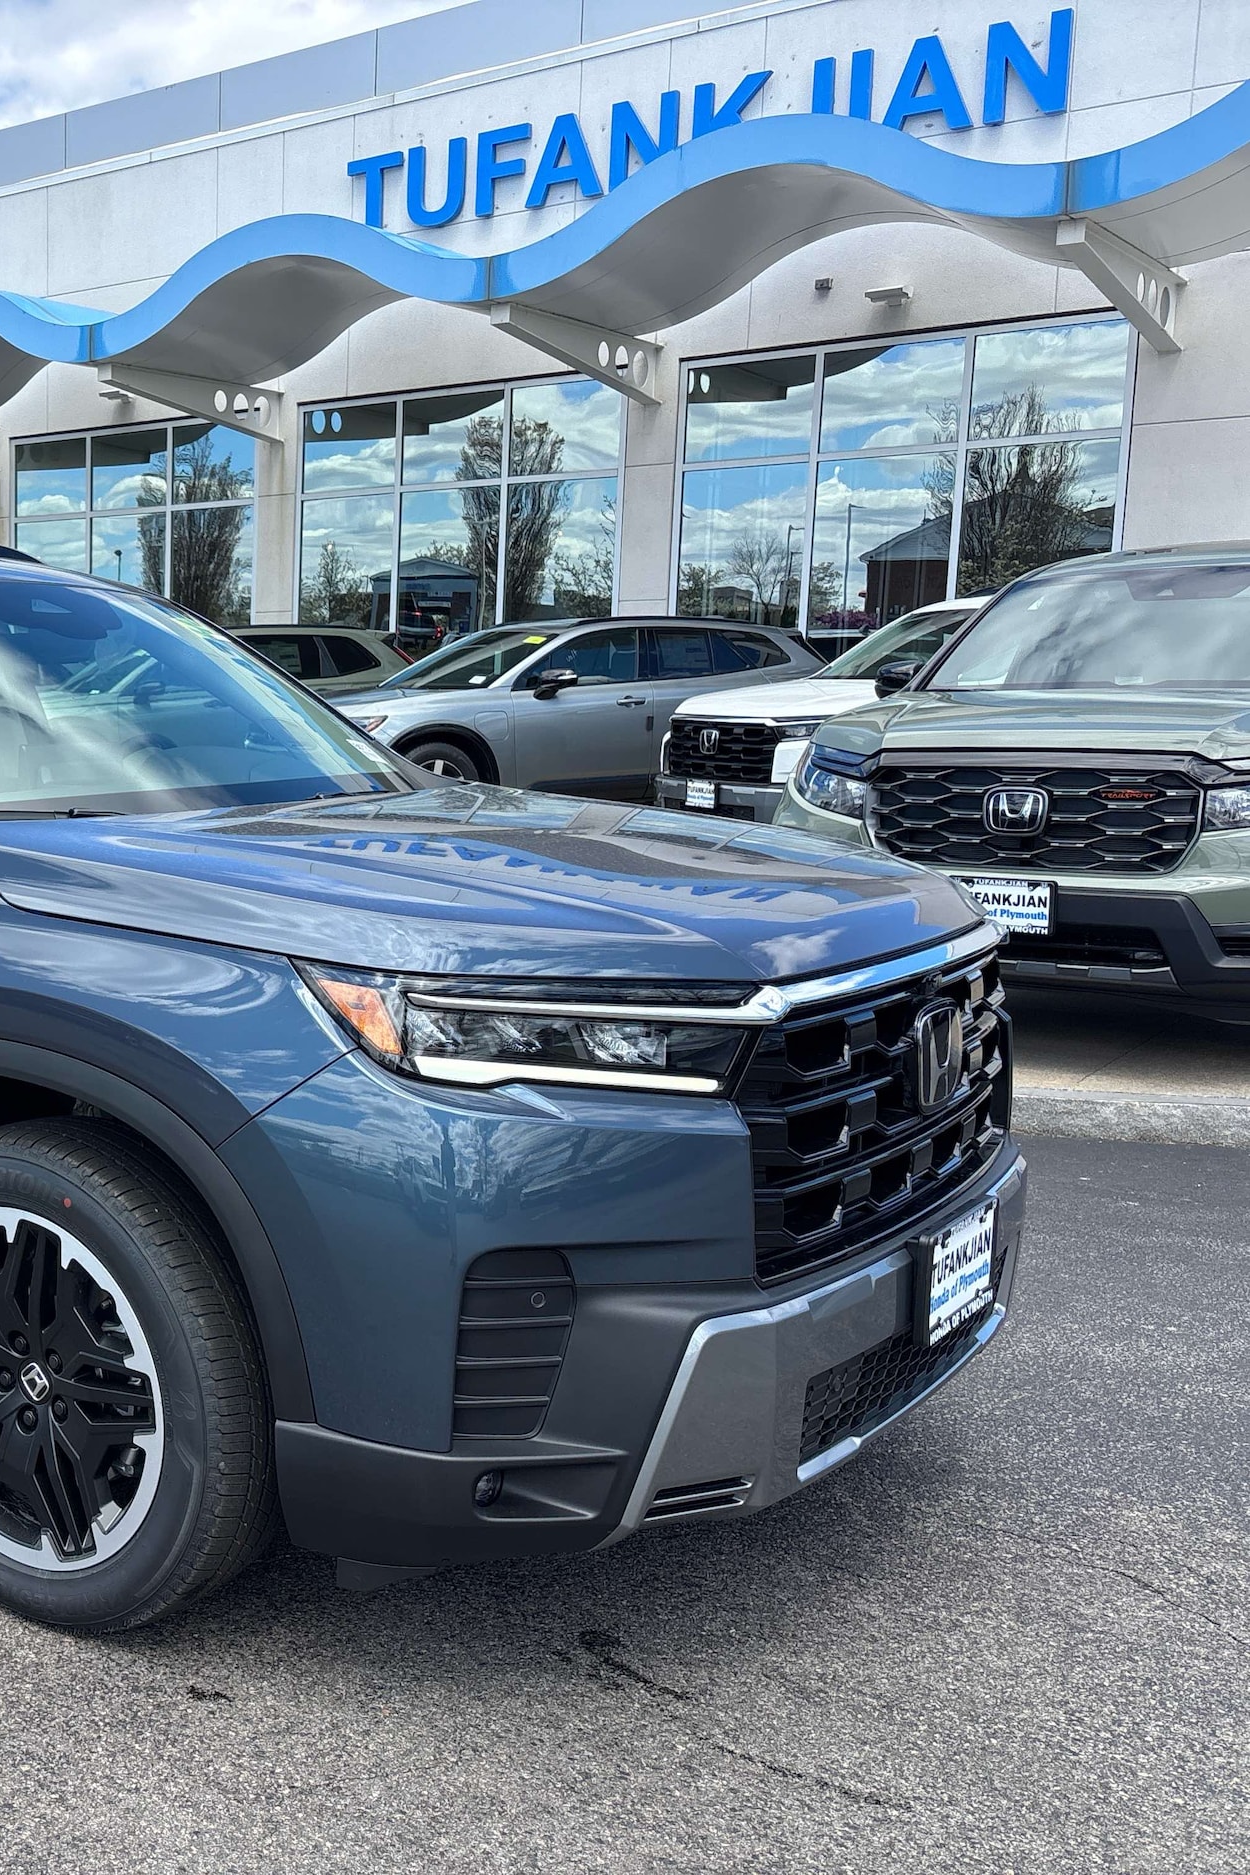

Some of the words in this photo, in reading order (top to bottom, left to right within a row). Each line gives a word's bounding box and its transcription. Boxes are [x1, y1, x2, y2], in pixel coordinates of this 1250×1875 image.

[973, 878, 1028, 888] TUFANKJIAN
[970, 891, 1048, 909] FANKJIAN
[987, 908, 997, 917] of
[999, 908, 1048, 921] Plymouth
[1004, 924, 1048, 935] LYMOUTH
[931, 1227, 992, 1288] TUFANKJIAN
[950, 1277, 959, 1298] of
[958, 1258, 990, 1294] Plymouth
[930, 1321, 951, 1347] HONDA
[951, 1312, 960, 1328] OF
[960, 1288, 994, 1321] PLYMOUTH
